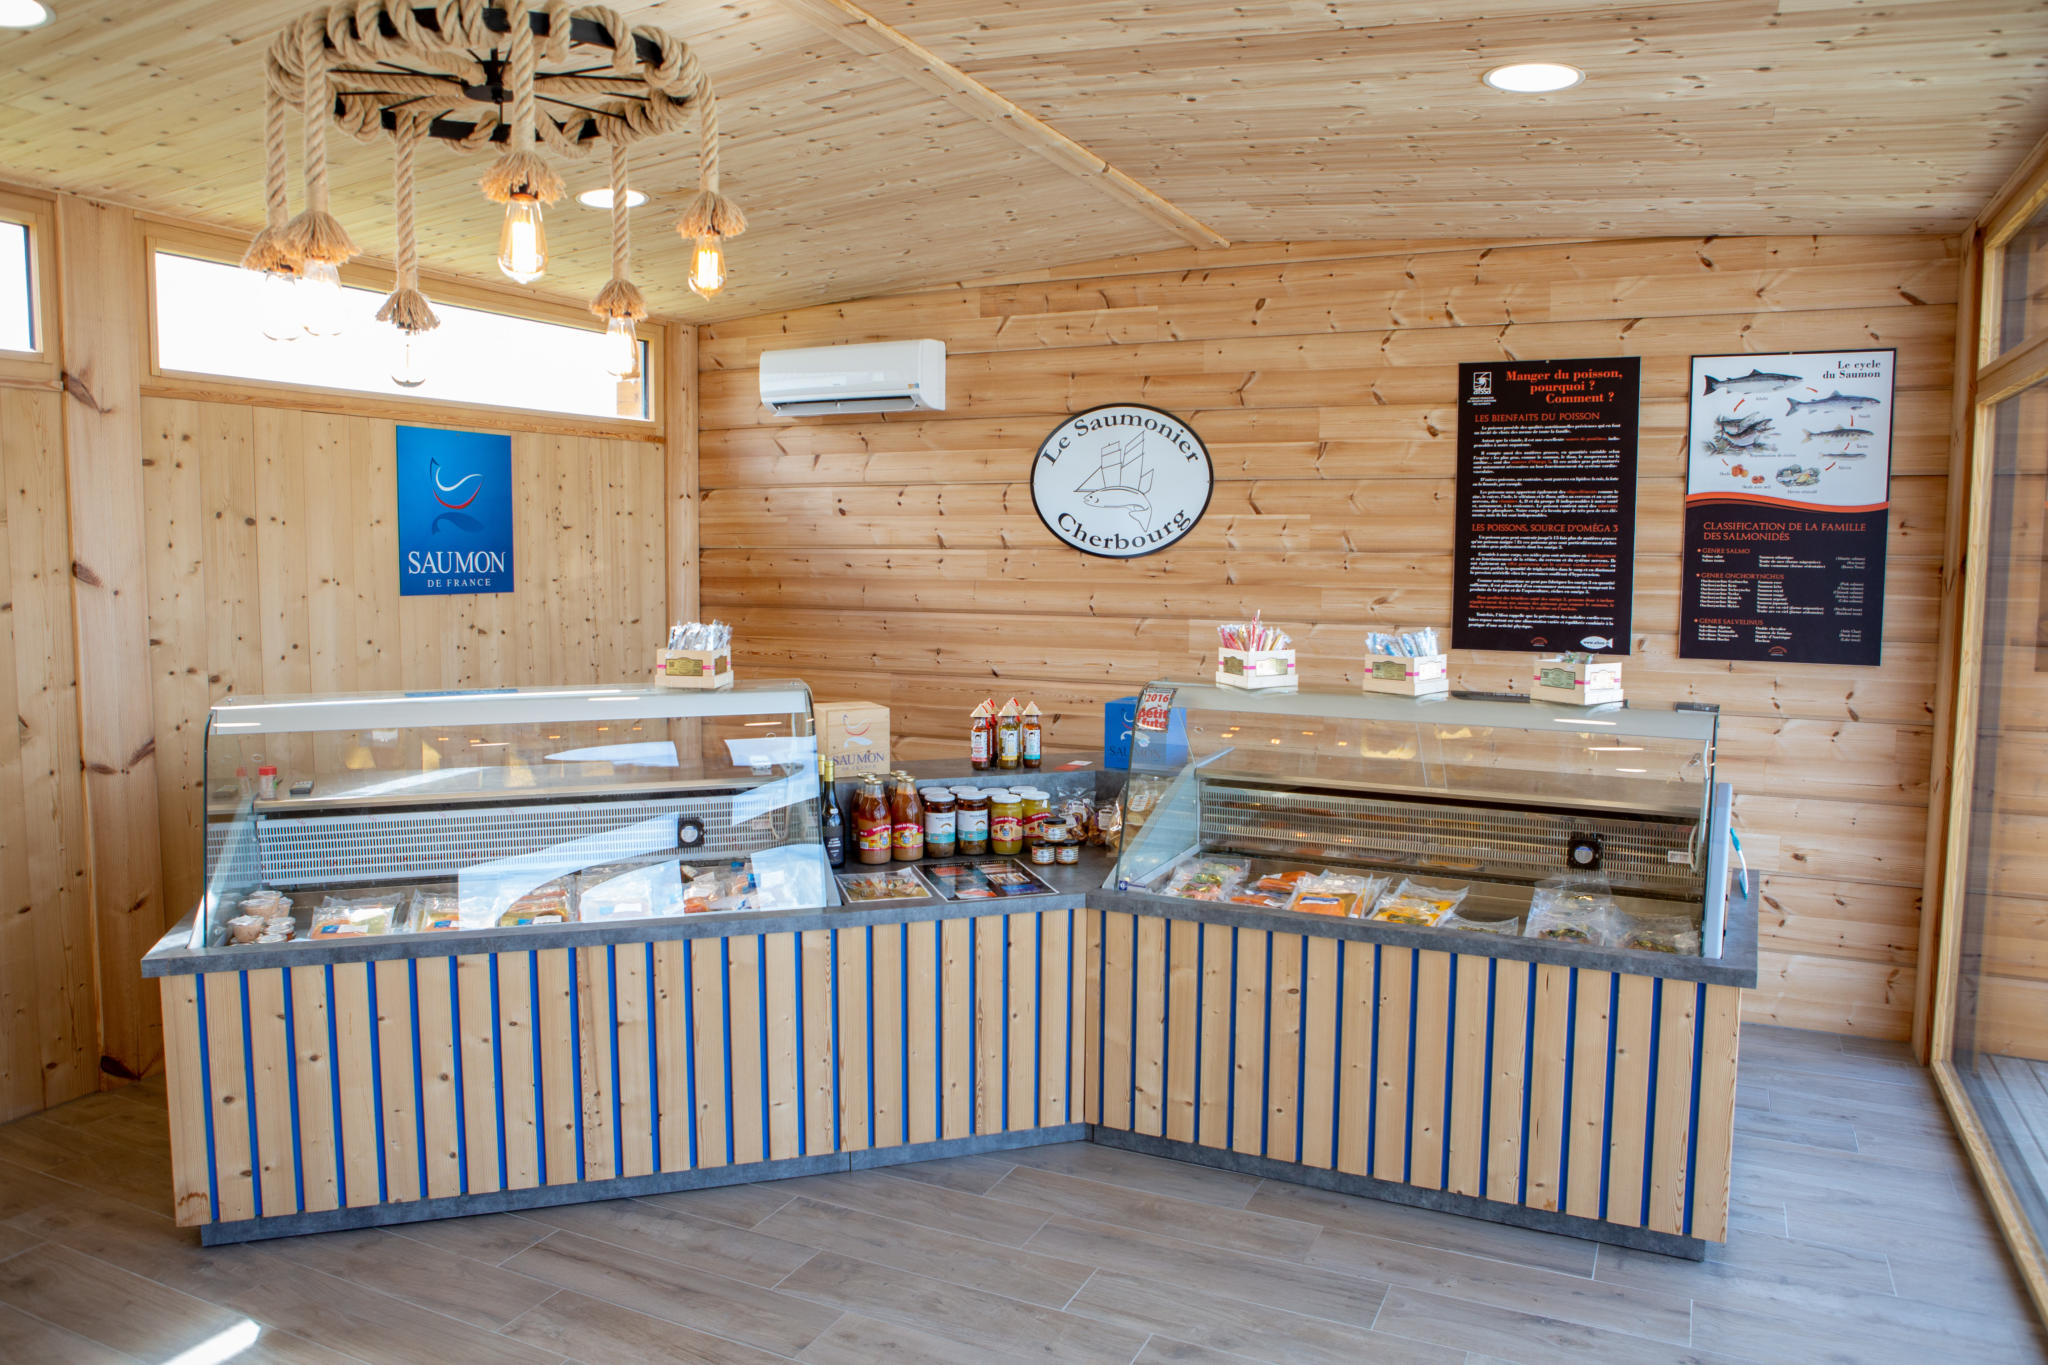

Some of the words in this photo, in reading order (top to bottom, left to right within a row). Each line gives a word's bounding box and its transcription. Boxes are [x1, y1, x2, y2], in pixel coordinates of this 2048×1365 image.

[1837, 360, 1850, 370] Le
[1854, 360, 1881, 373] cycle
[1506, 371, 1550, 383] Manger
[1554, 370, 1570, 380] du
[1573, 369, 1623, 380] poisson,
[1822, 369, 1835, 379] du
[1839, 371, 1881, 379] Saumon
[1530, 382, 1586, 394] pourquoi
[1589, 380, 1596, 391] ?
[1546, 392, 1604, 404] Comment
[1608, 392, 1616, 403] ?
[1475, 414, 1489, 423] LES
[1491, 412, 1539, 422] BIENFAITS
[1541, 412, 1556, 421] DU
[1559, 412, 1600, 421] POISSON
[1042, 436, 1070, 466] Le
[1074, 413, 1199, 463] Saumonier
[1057, 509, 1191, 550] Cherbourg
[1472, 523, 1485, 532] LES
[1530, 524, 1565, 532] SOURCE
[1612, 524, 1618, 532] 3
[1703, 521, 1786, 531] CLASSIFICATION
[1789, 522, 1802, 531] DE
[1805, 522, 1817, 531] LA
[1821, 523, 1867, 532] FAMILLE
[1703, 531, 1721, 541] DES
[1723, 531, 1790, 541] SALMONIDÉS
[408, 551, 506, 574] SAUMON
[427, 579, 442, 588] DE
[446, 578, 492, 587] FRANCE
[1145, 694, 1170, 703] 2016
[832, 752, 885, 766] SAUMON
